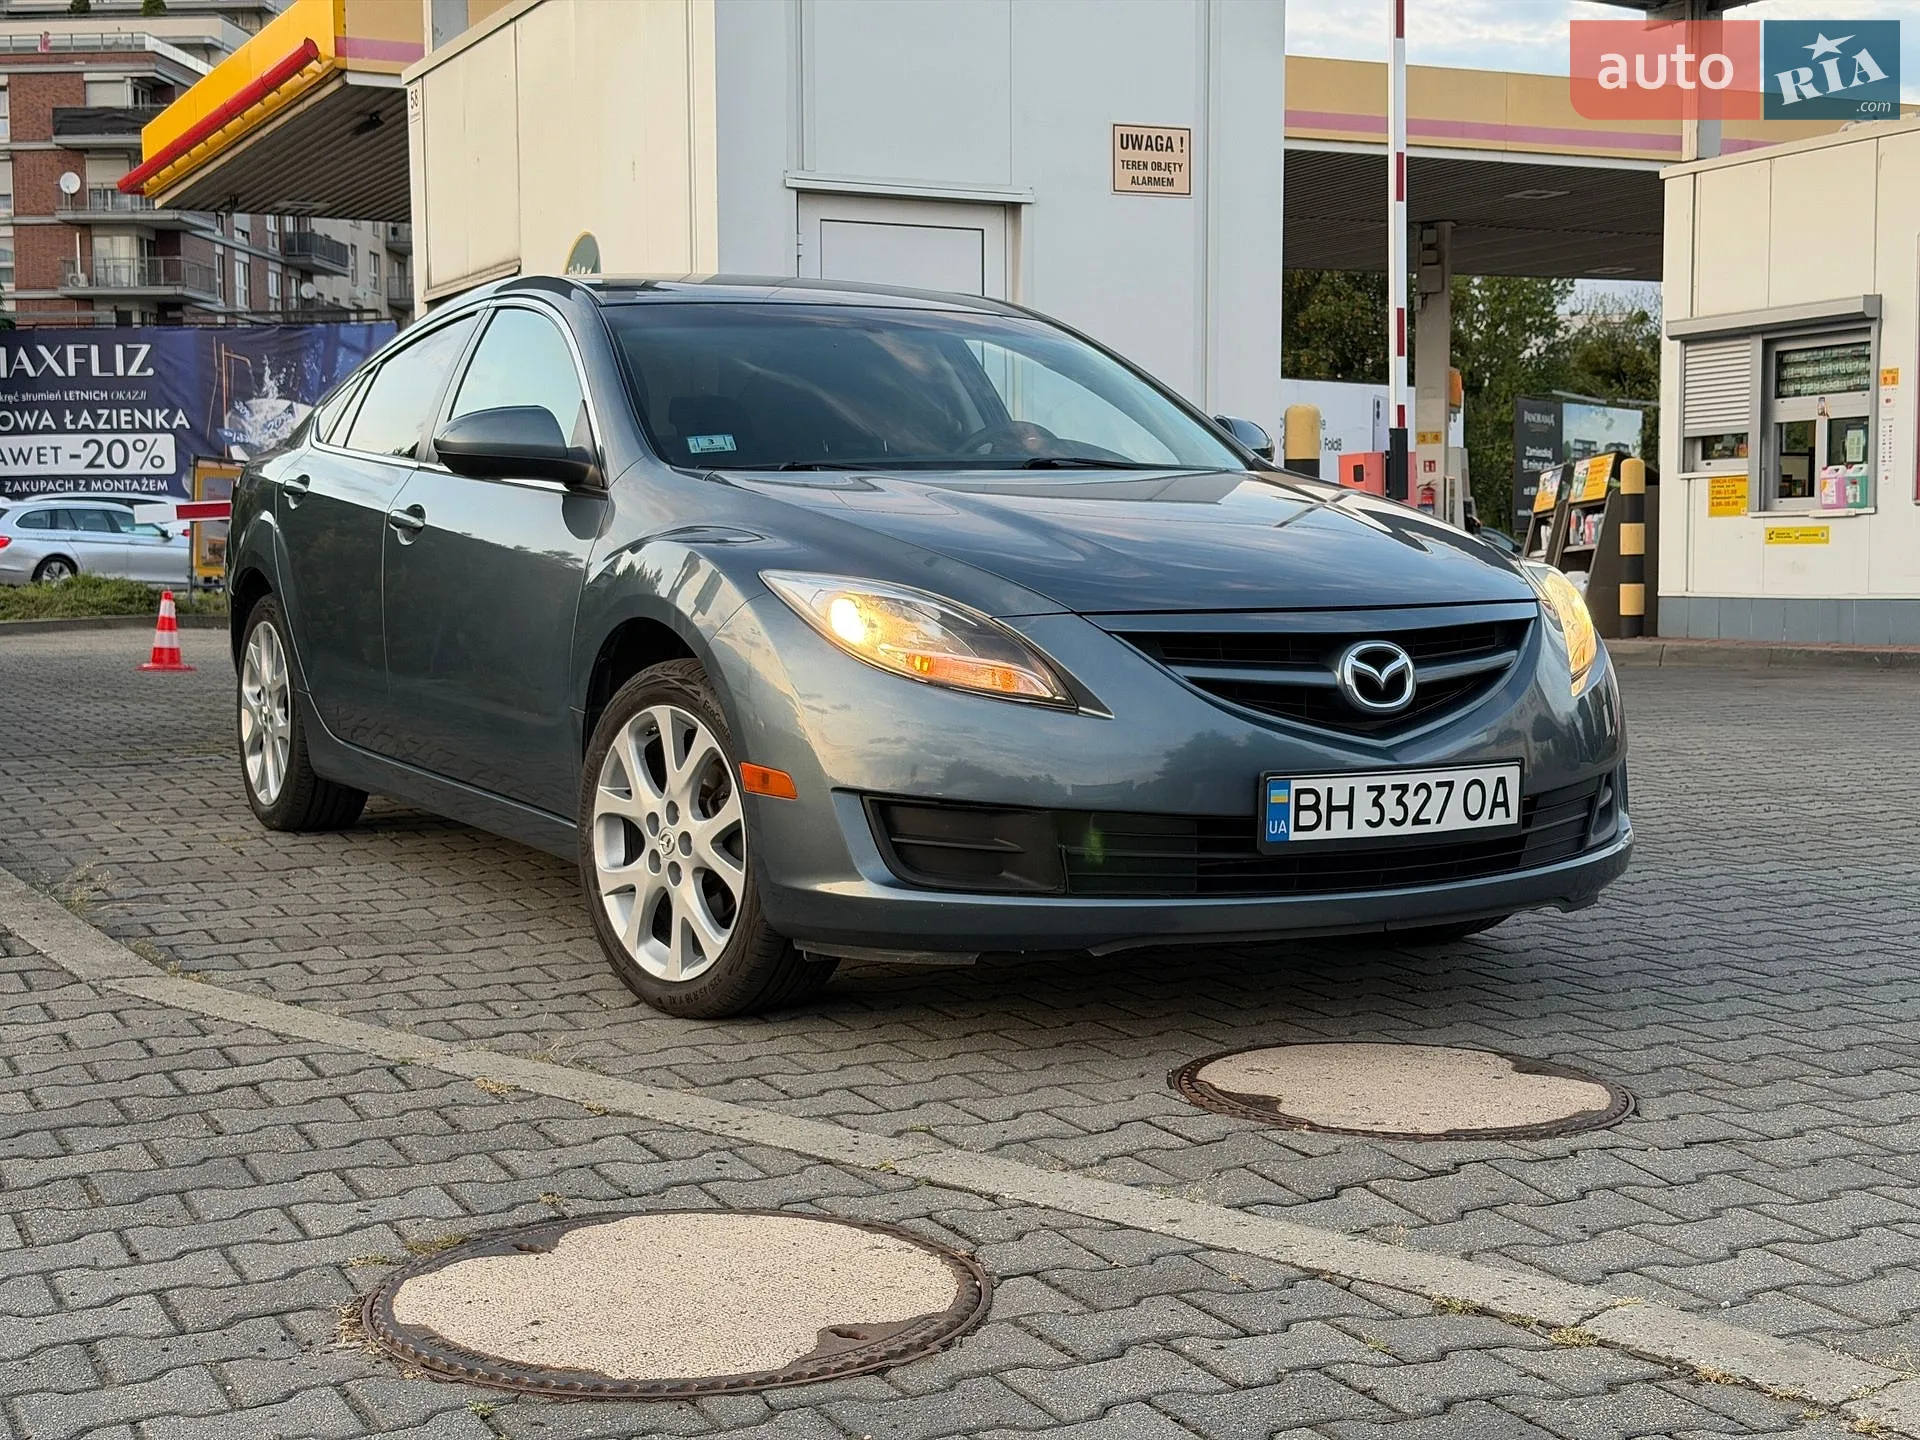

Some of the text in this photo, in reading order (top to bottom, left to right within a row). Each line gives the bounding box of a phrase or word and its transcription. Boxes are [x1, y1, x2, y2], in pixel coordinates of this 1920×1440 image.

[410, 89, 418, 109] 58
[1120, 133, 1174, 153] UWAGA
[1120, 160, 1184, 175] TEREN OBJĘTY
[1130, 176, 1175, 187] ALARMEM
[0, 344, 154, 378] AXFLIZ
[21, 389, 62, 402] strumień
[64, 390, 108, 401] LETNICH
[111, 390, 147, 401] OKAZJI
[64, 408, 191, 430] ŁAZIENKA
[69, 437, 166, 470] -20%
[5, 477, 169, 493] ZAKUPACH Z MONTAŻEM
[1293, 776, 1511, 833] BH 3327 OA
[1269, 819, 1288, 834] UA
